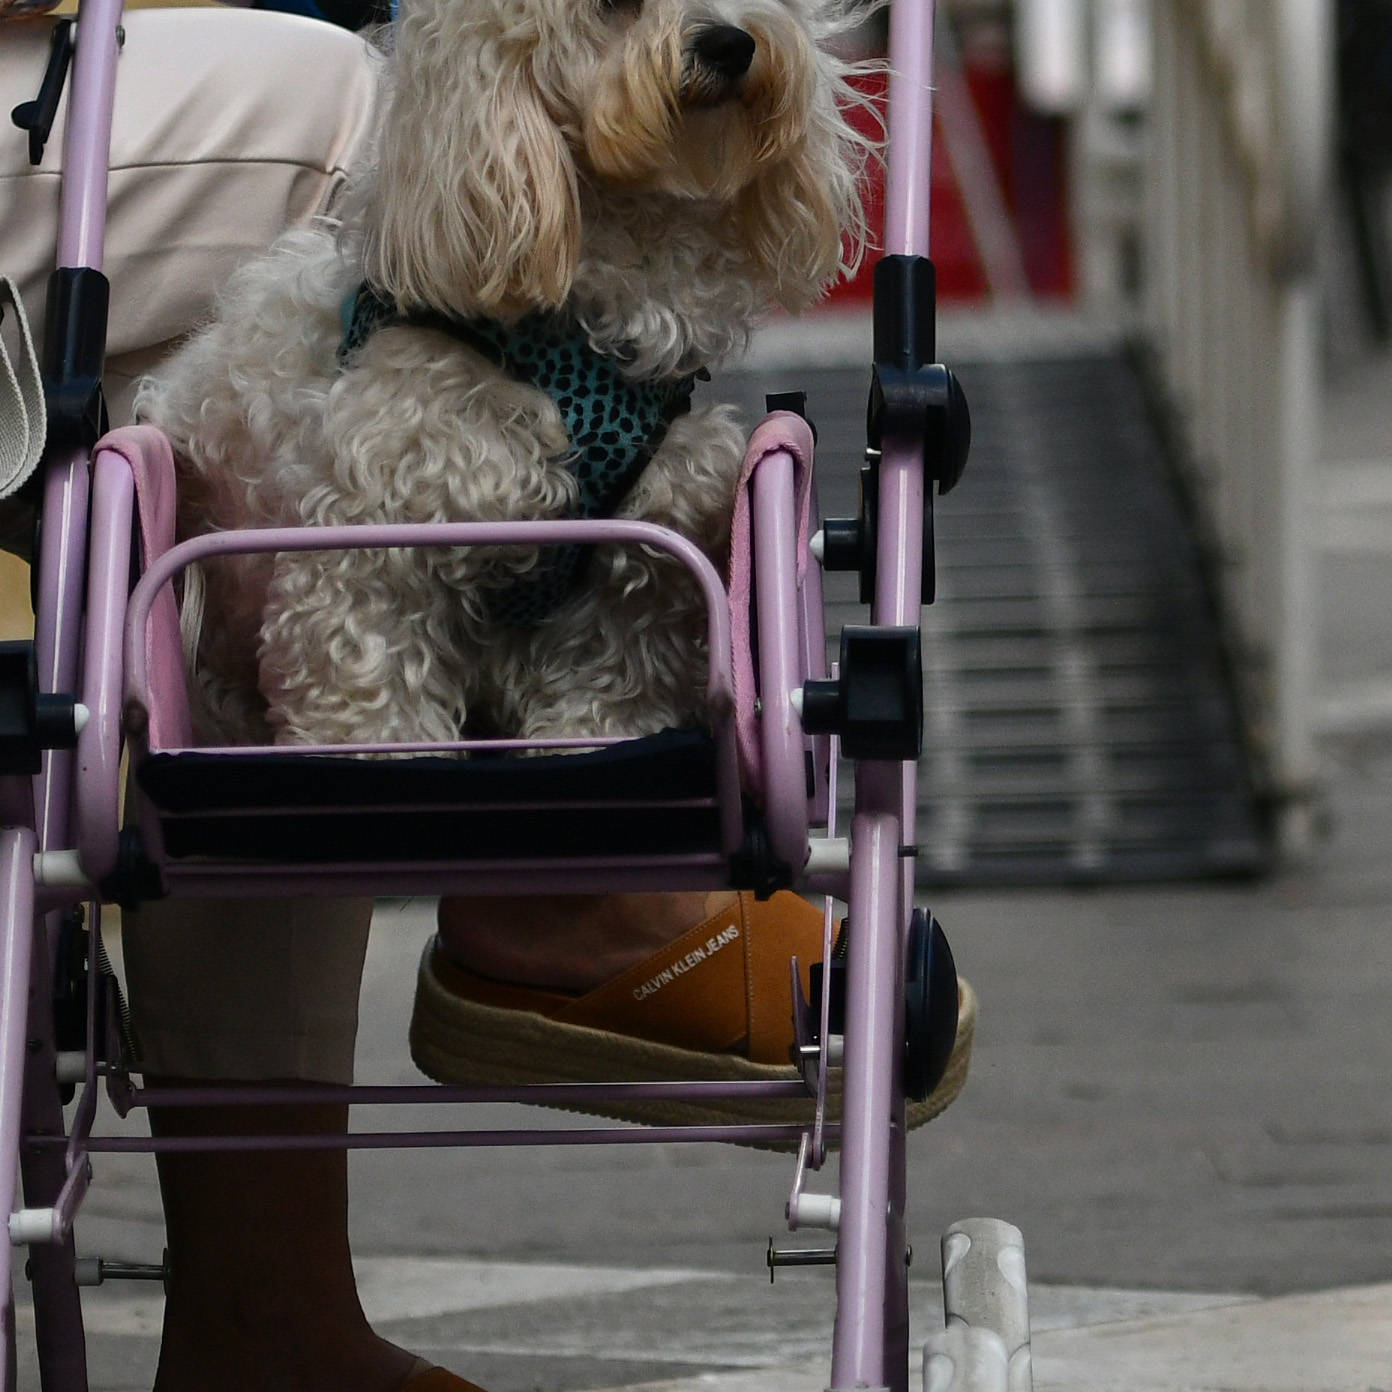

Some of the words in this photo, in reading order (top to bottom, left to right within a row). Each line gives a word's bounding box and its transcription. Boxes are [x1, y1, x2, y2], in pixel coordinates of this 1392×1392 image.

[632, 969, 674, 1000] CALVIN
[671, 947, 706, 976] KLEIN
[705, 925, 739, 955] JEANS
